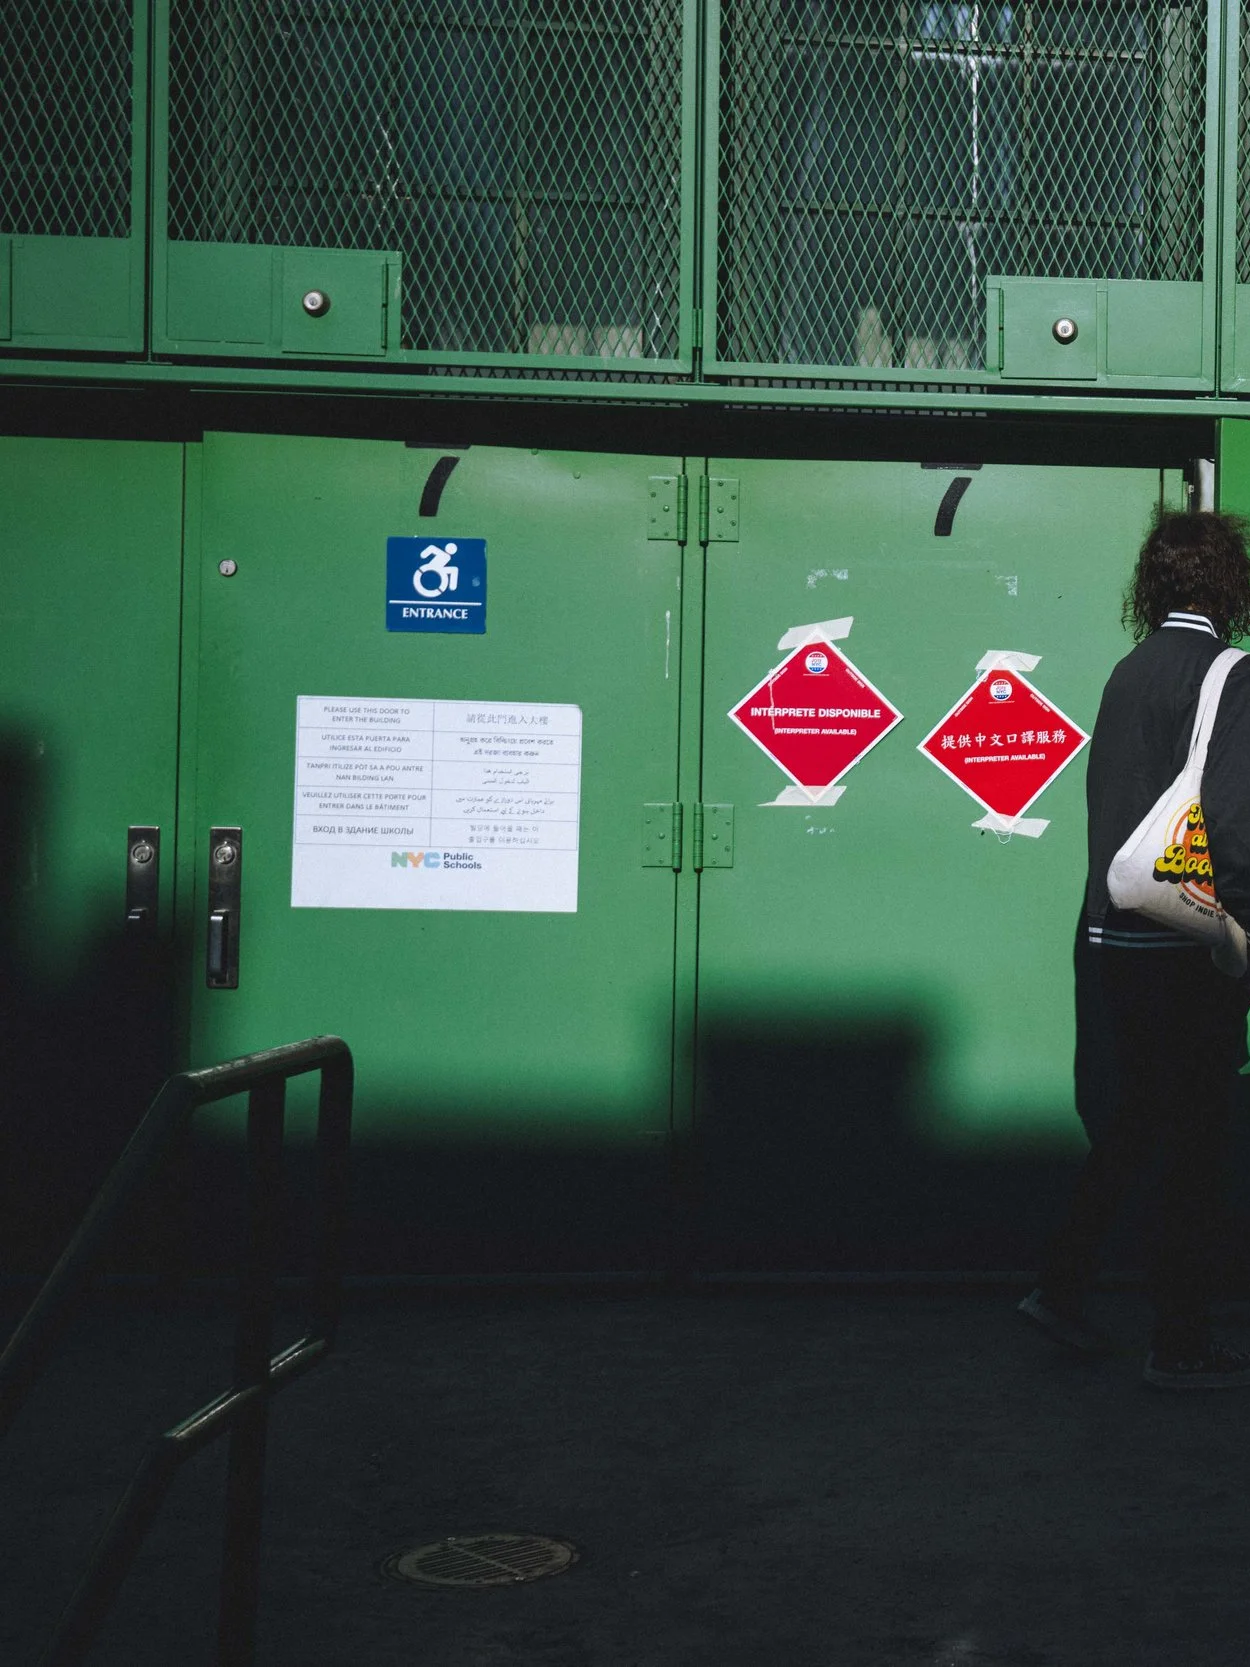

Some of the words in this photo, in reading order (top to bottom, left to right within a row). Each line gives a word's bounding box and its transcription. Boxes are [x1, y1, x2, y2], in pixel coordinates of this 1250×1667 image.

[402, 608, 468, 619] ENTRANCE
[818, 709, 881, 718] DISPONIBLE
[941, 729, 1066, 750] 提供中文口譯服務
[313, 826, 336, 834] ВХОД
[391, 852, 440, 869] NYC
[443, 852, 474, 861] Public
[443, 861, 482, 870] Schools
[1179, 892, 1195, 907] SHOP
[1195, 905, 1214, 918] INDIE
